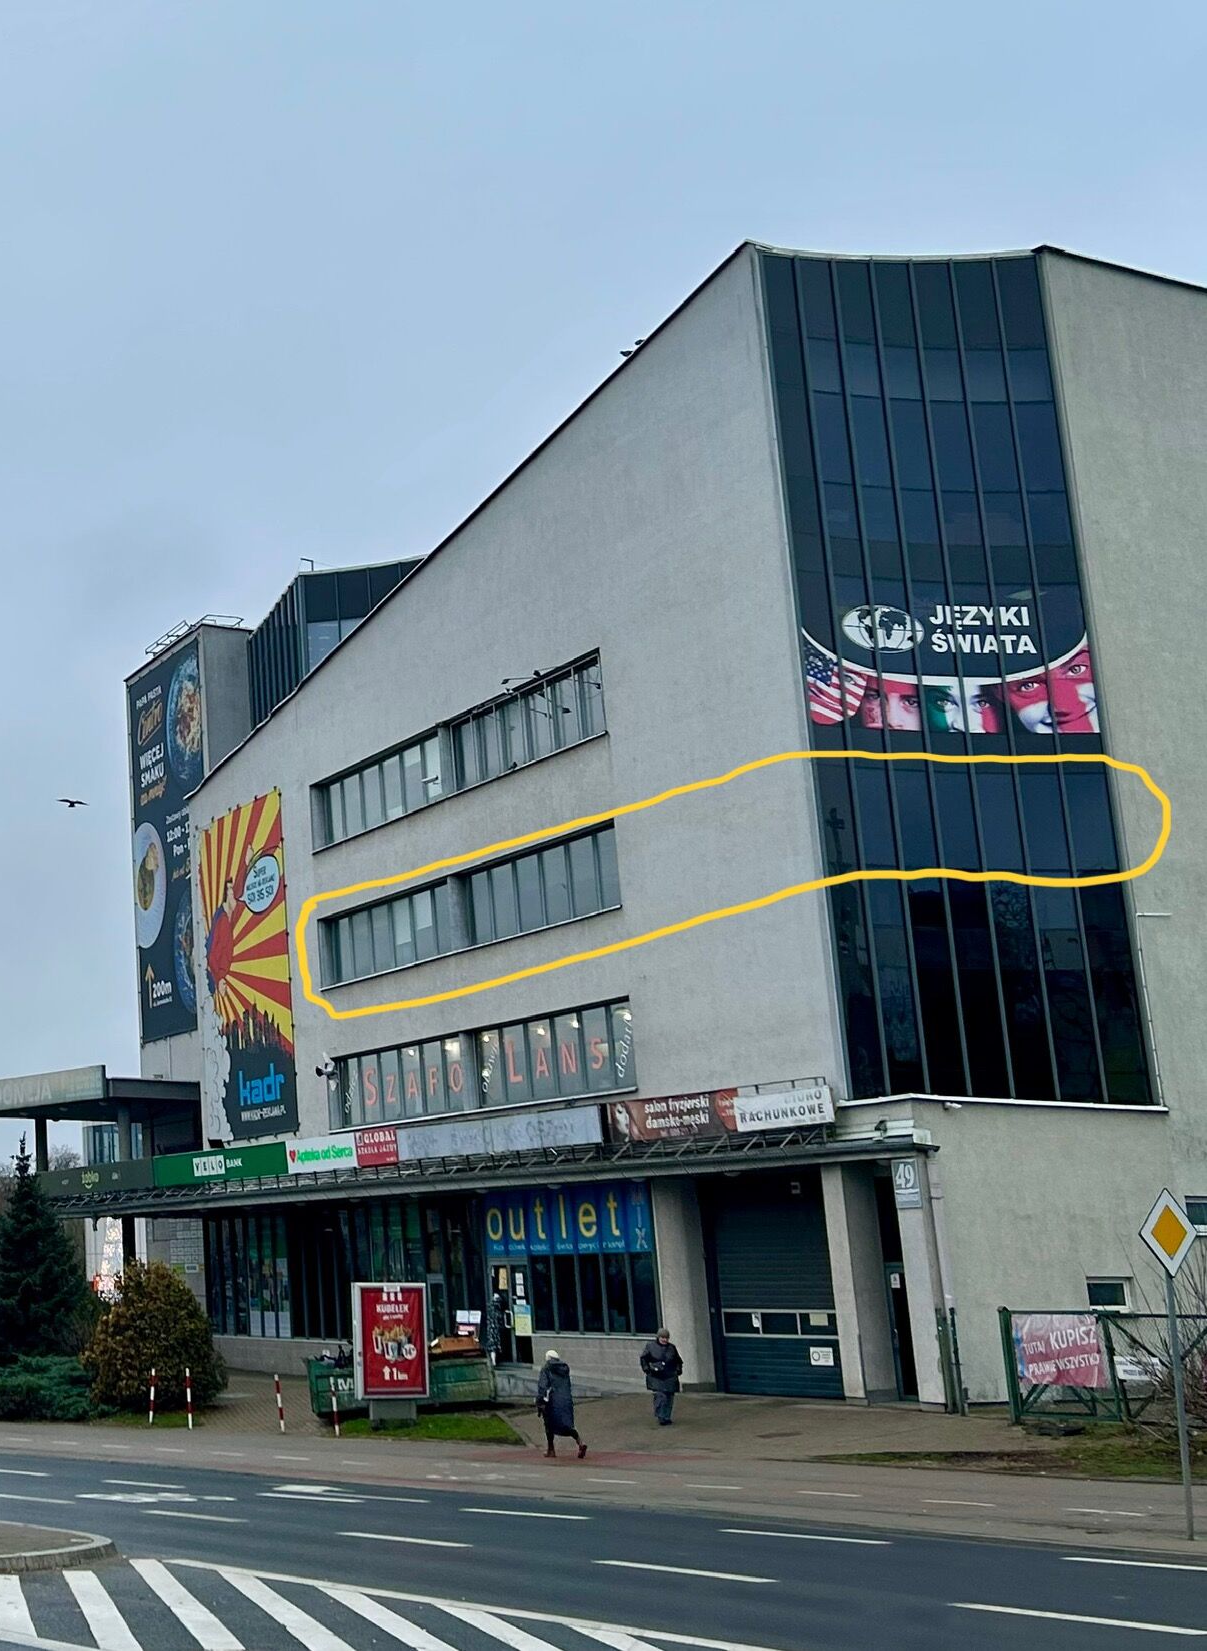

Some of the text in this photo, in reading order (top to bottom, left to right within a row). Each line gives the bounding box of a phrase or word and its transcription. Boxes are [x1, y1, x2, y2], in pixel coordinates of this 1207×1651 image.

[929, 605, 1030, 630] JĘZYKI
[931, 629, 1037, 654] ŚWIATA
[139, 742, 164, 770] WIĘCEJ
[140, 762, 165, 788] SMAKU
[239, 1063, 285, 1106] kadr
[739, 1103, 825, 1123] RACHUNKOWE
[364, 1130, 396, 1143] GLOBAL
[226, 1158, 243, 1168] BANK
[321, 1145, 331, 1160] od
[331, 1145, 353, 1158] Serca
[896, 1163, 914, 1188] 49
[486, 1191, 621, 1241] outlet
[1050, 1325, 1097, 1350] KUPISZ
[1056, 1353, 1100, 1370] WSZYSTKO
